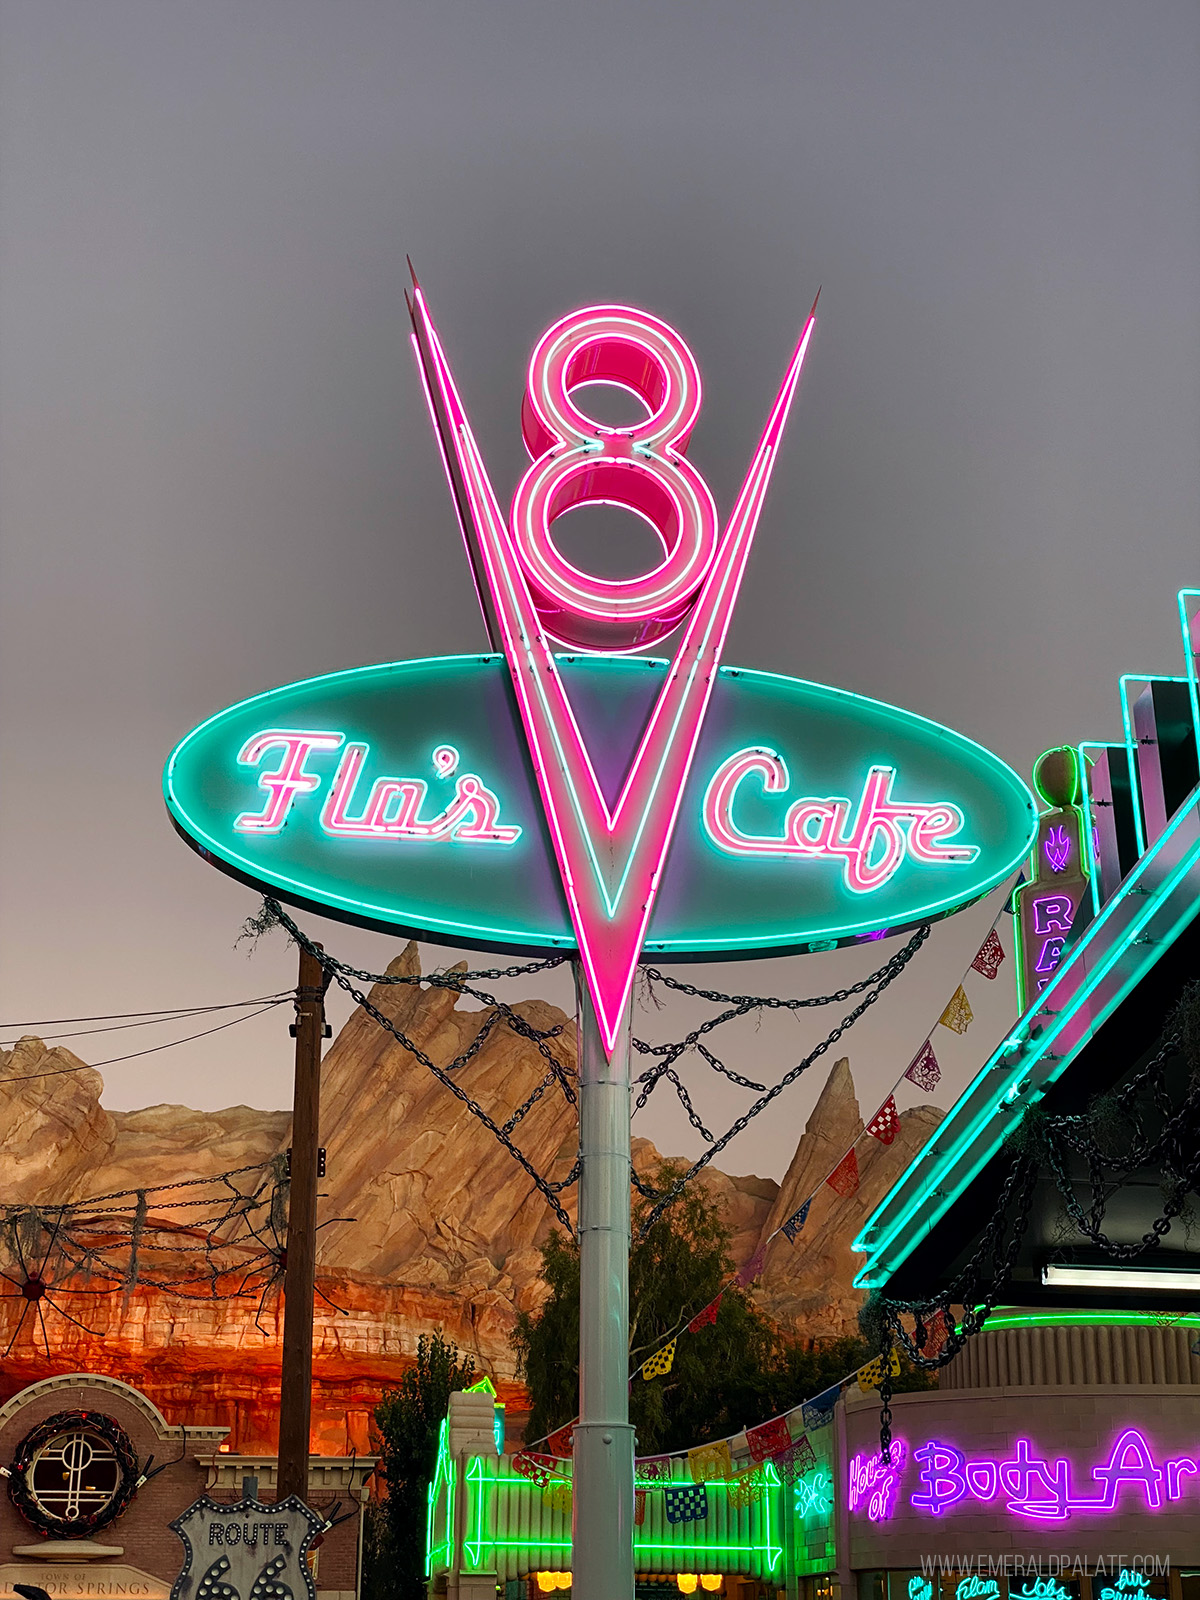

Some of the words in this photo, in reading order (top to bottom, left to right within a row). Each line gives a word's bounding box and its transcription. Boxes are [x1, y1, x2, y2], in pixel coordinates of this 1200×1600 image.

[232, 728, 523, 845] Flo's
[702, 745, 982, 894] Cafe
[1032, 895, 1074, 991] RA
[868, 1475, 893, 1521] of
[910, 1441, 1068, 1520] Body
[208, 1522, 289, 1546] ROUTE
[40, 1573, 69, 1581] TOWN
[76, 1582, 150, 1595] SPRINGS
[195, 1554, 294, 1600] 66
[1114, 1569, 1151, 1591] Air
